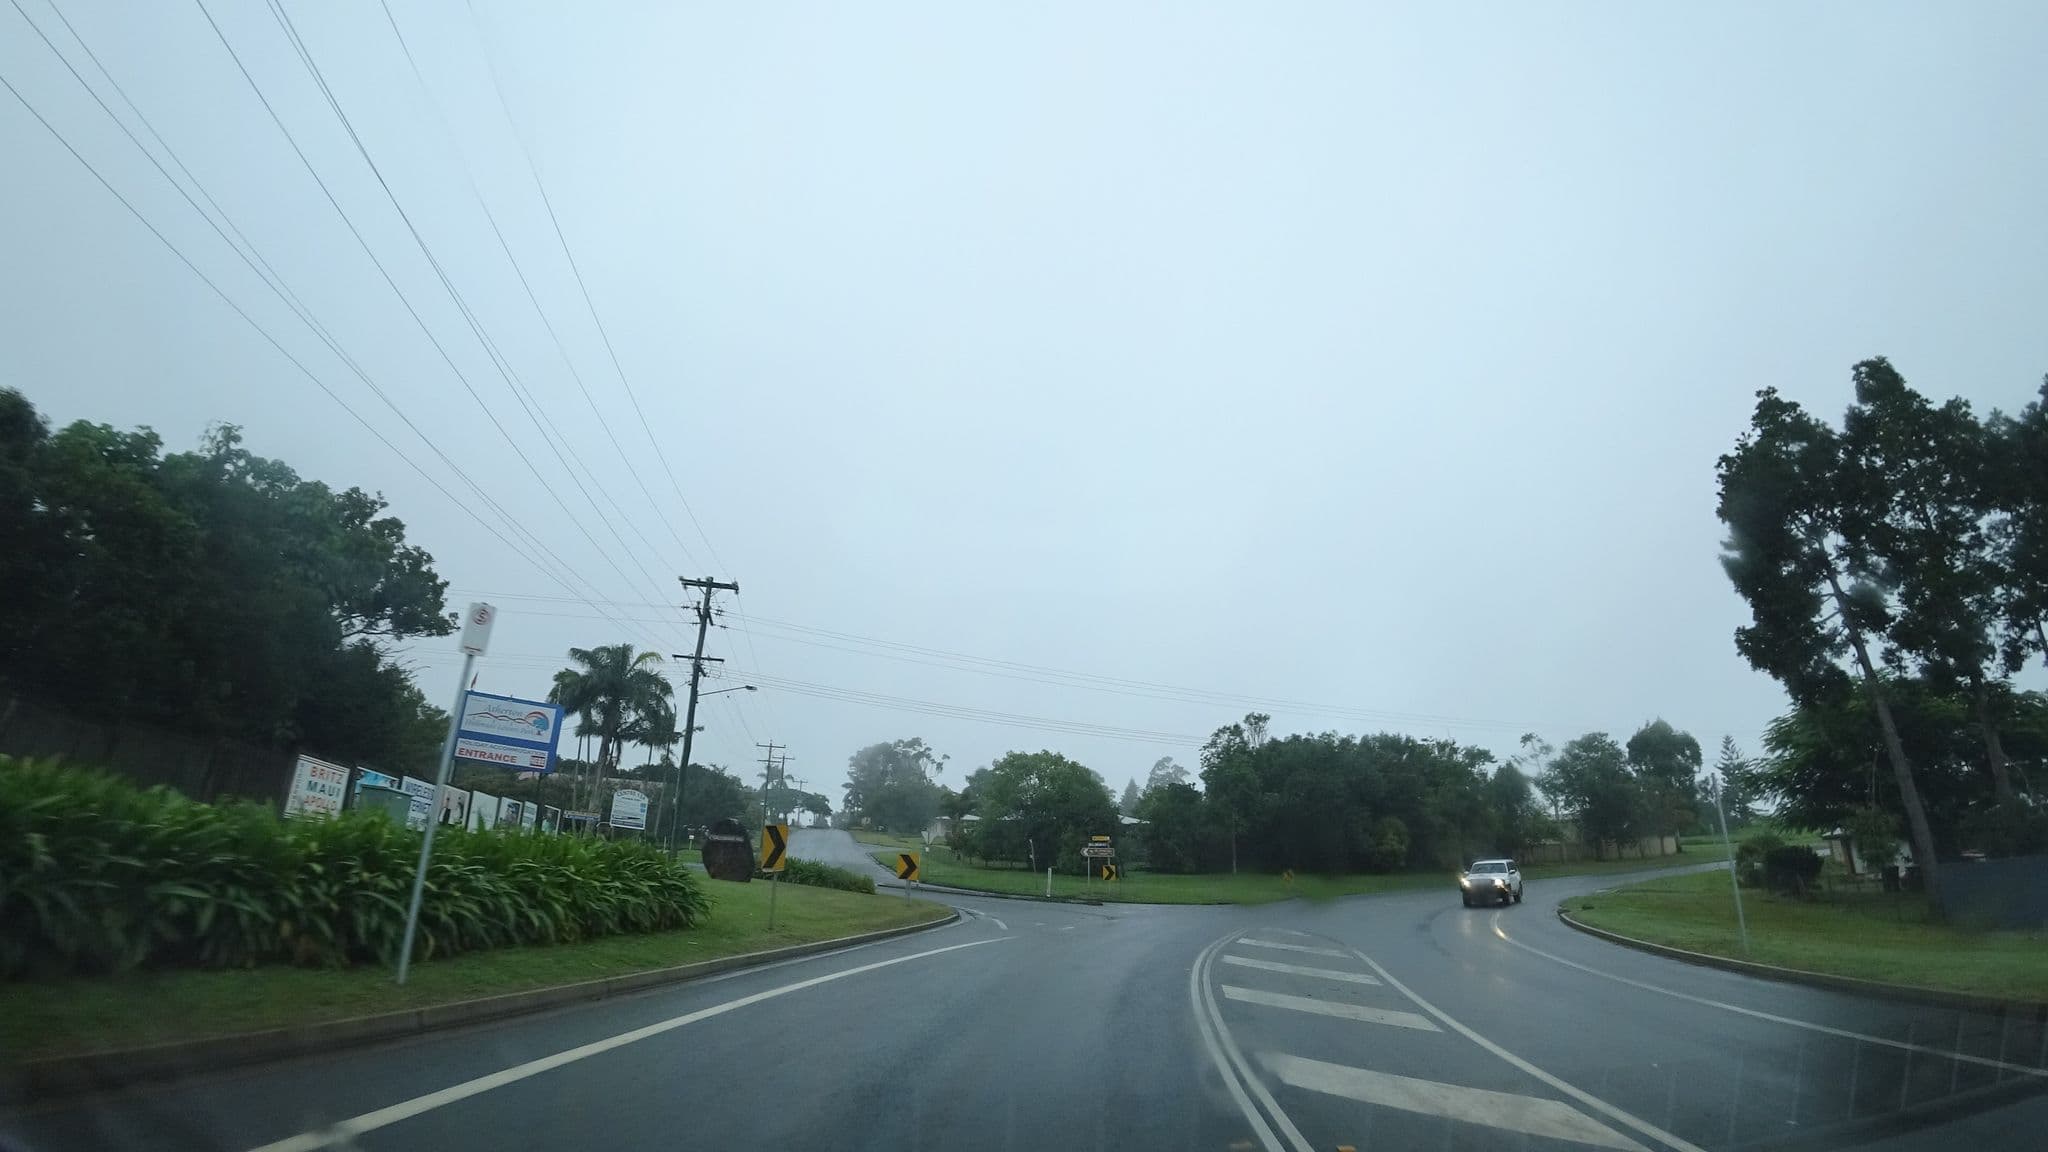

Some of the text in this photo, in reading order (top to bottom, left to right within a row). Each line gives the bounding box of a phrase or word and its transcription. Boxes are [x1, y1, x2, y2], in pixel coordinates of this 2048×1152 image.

[458, 747, 518, 763] ENTRANCE
[310, 766, 344, 784] BRITZ
[306, 780, 341, 797] MAUI
